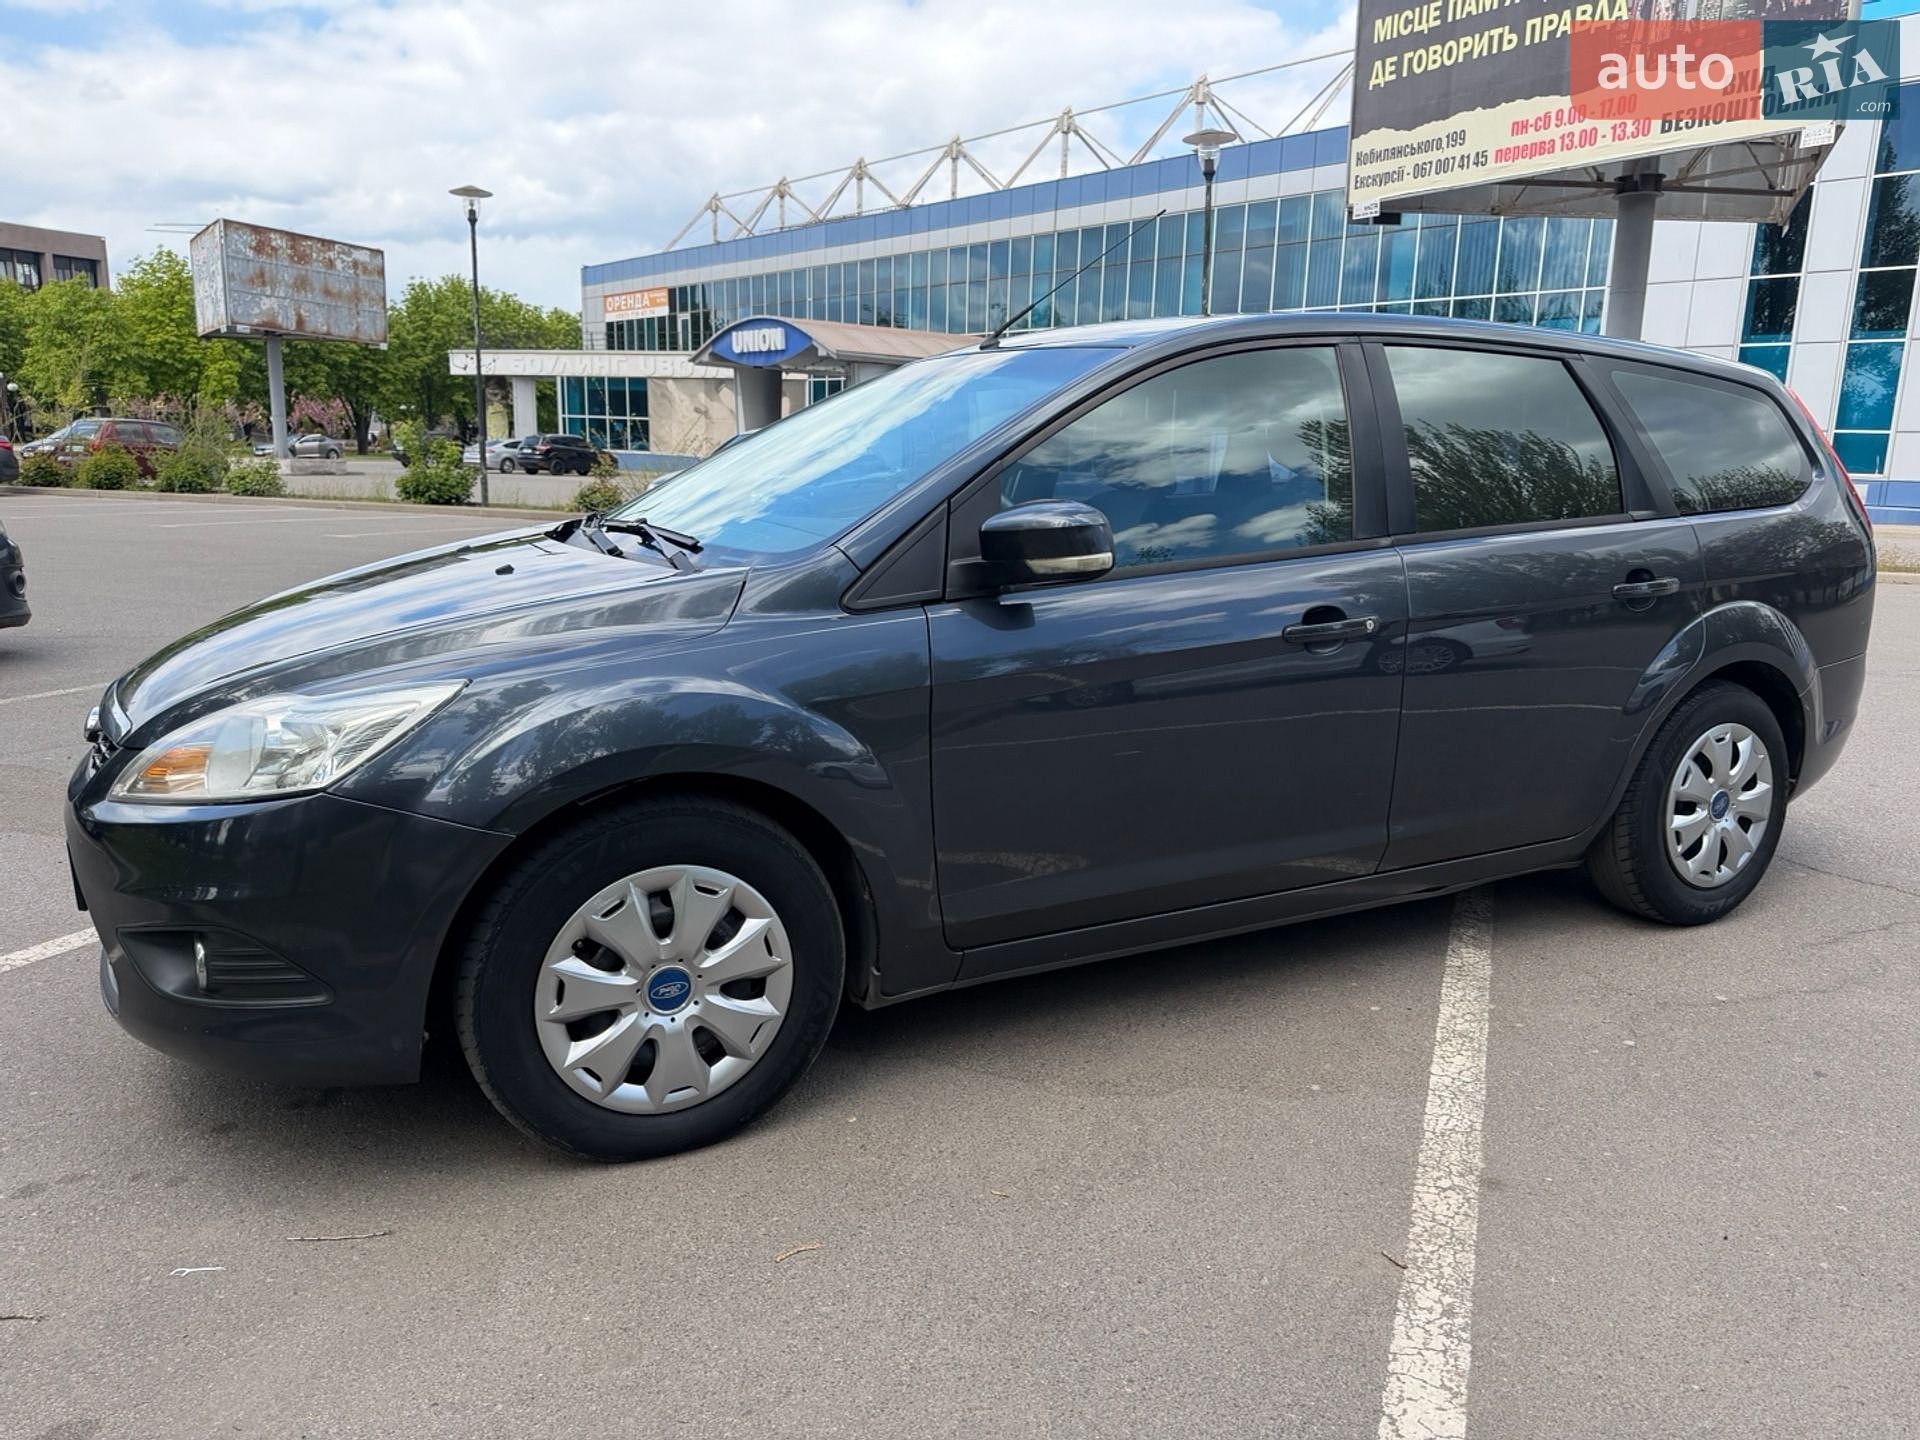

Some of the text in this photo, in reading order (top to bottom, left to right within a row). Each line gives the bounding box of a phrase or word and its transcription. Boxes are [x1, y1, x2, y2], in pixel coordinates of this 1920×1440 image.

[1373, 1, 1443, 44] МІСЦЕ
[1368, 0, 1629, 91] ДЕ ГОВОРИТЬ ПРАВДА
[1494, 138, 1556, 164] перерва
[1559, 127, 1599, 152] 13.00
[1611, 117, 1653, 143] 13.30
[1511, 111, 1552, 137] пн-сб
[606, 291, 651, 312] ОРЕНДА
[732, 326, 786, 354] UNION
